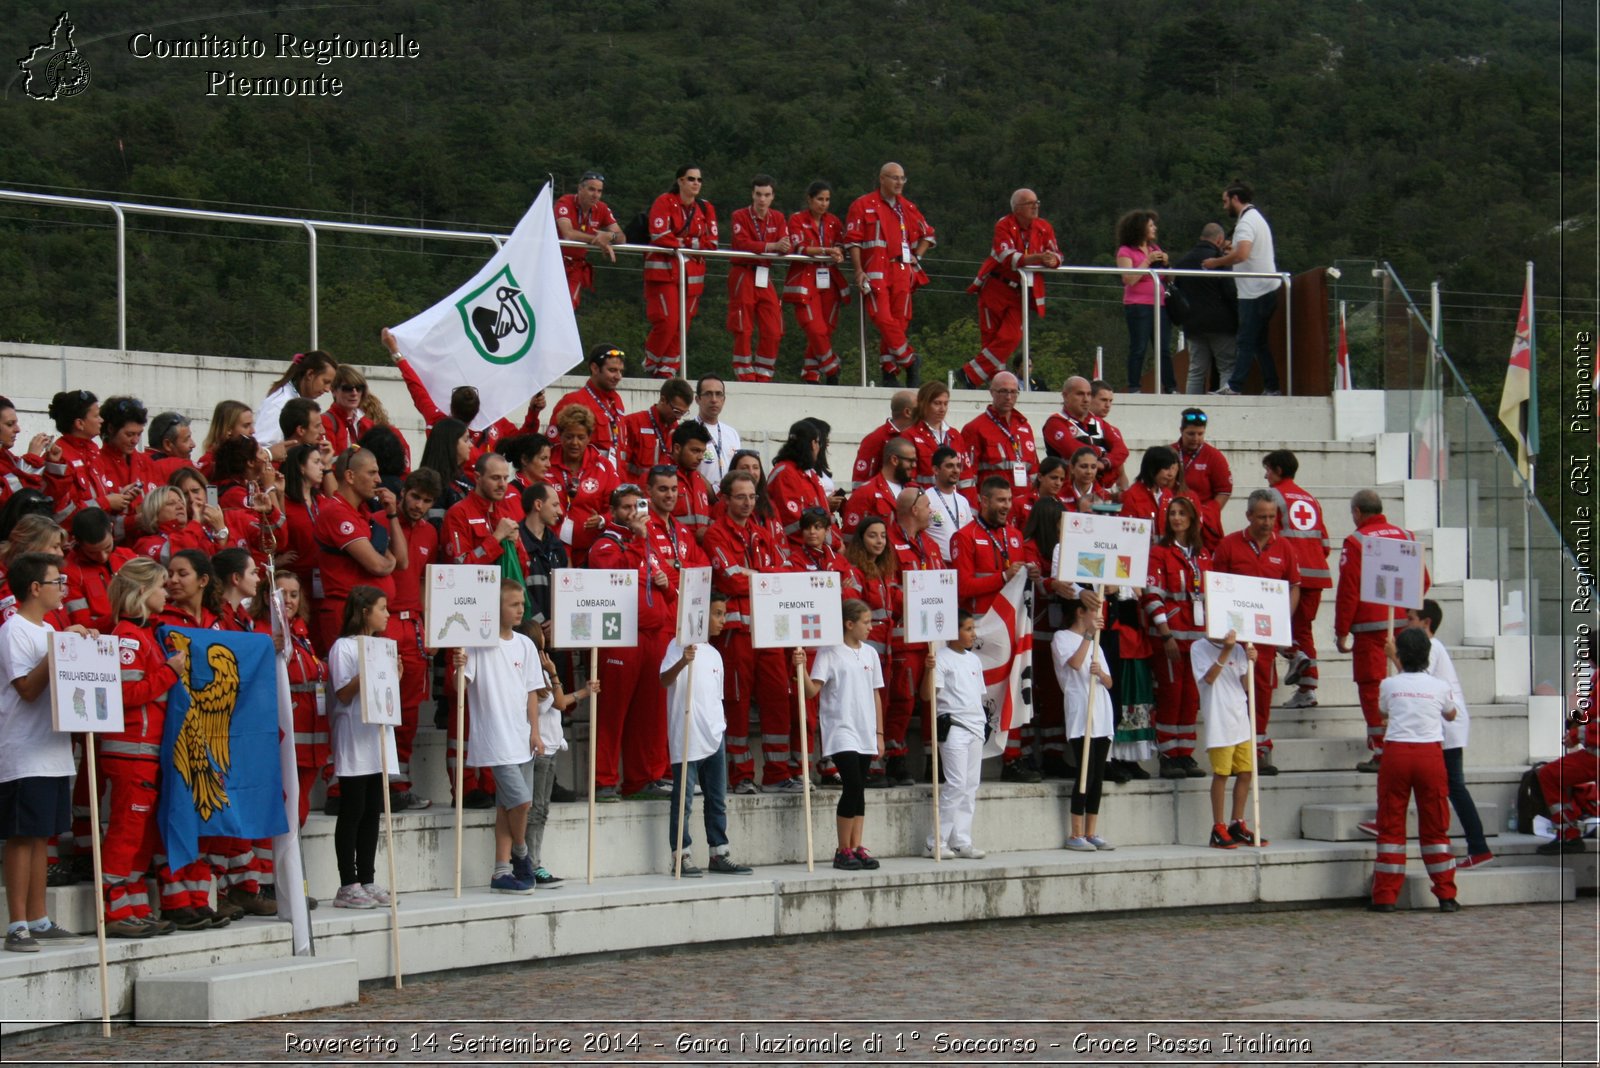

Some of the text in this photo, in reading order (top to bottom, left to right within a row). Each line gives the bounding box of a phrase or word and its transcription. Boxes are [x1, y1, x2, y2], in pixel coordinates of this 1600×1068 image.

[1094, 541, 1119, 551] SICILIA
[453, 597, 477, 606] LIGURIA
[576, 599, 617, 608] LOMBARDIA
[778, 600, 815, 609] PIEMONTE
[920, 598, 944, 606] SARDEGNA
[1232, 600, 1265, 610] TOSCANA
[59, 671, 118, 683] FRIULI-VENEZIA GIULIA
